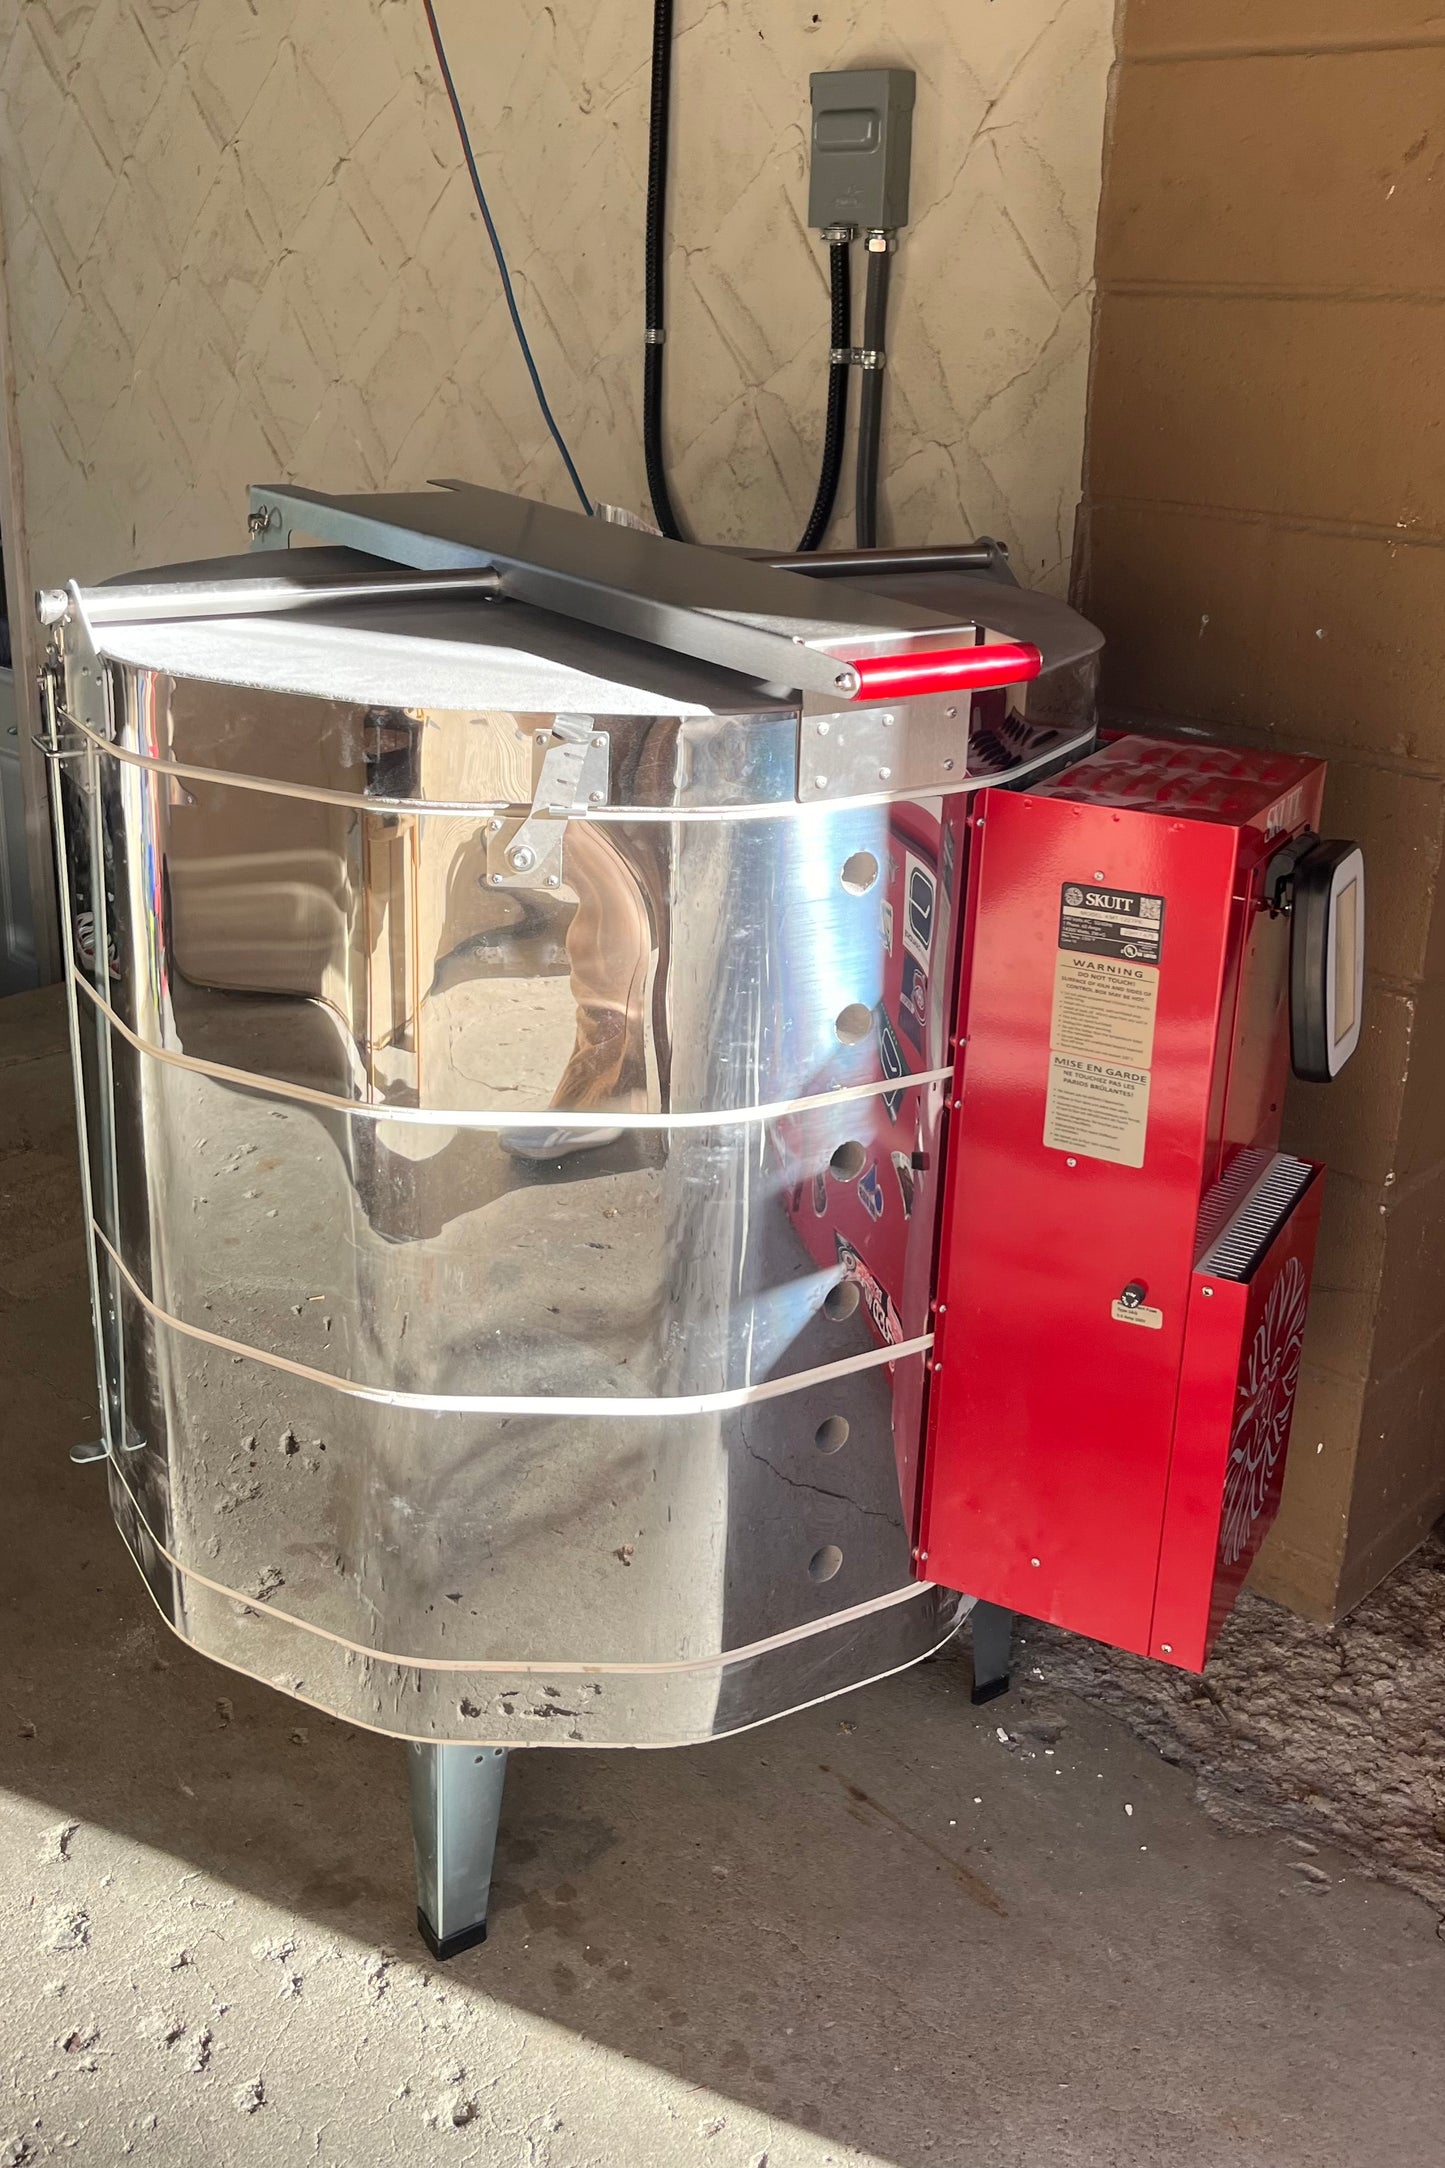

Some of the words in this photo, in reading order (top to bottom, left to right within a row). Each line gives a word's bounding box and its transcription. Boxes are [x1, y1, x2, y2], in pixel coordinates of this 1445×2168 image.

[1085, 892, 1133, 912] SKUTT
[1073, 959, 1144, 978] WARNING
[1091, 973, 1106, 981] NOT
[1066, 983, 1092, 992] CONTROL
[1055, 1057, 1083, 1069] MISE
[1086, 1063, 1102, 1073] EN
[1105, 1068, 1147, 1083] GARDE
[1074, 1072, 1107, 1084] TOUCHEZ
[1108, 1079, 1122, 1087] PAS
